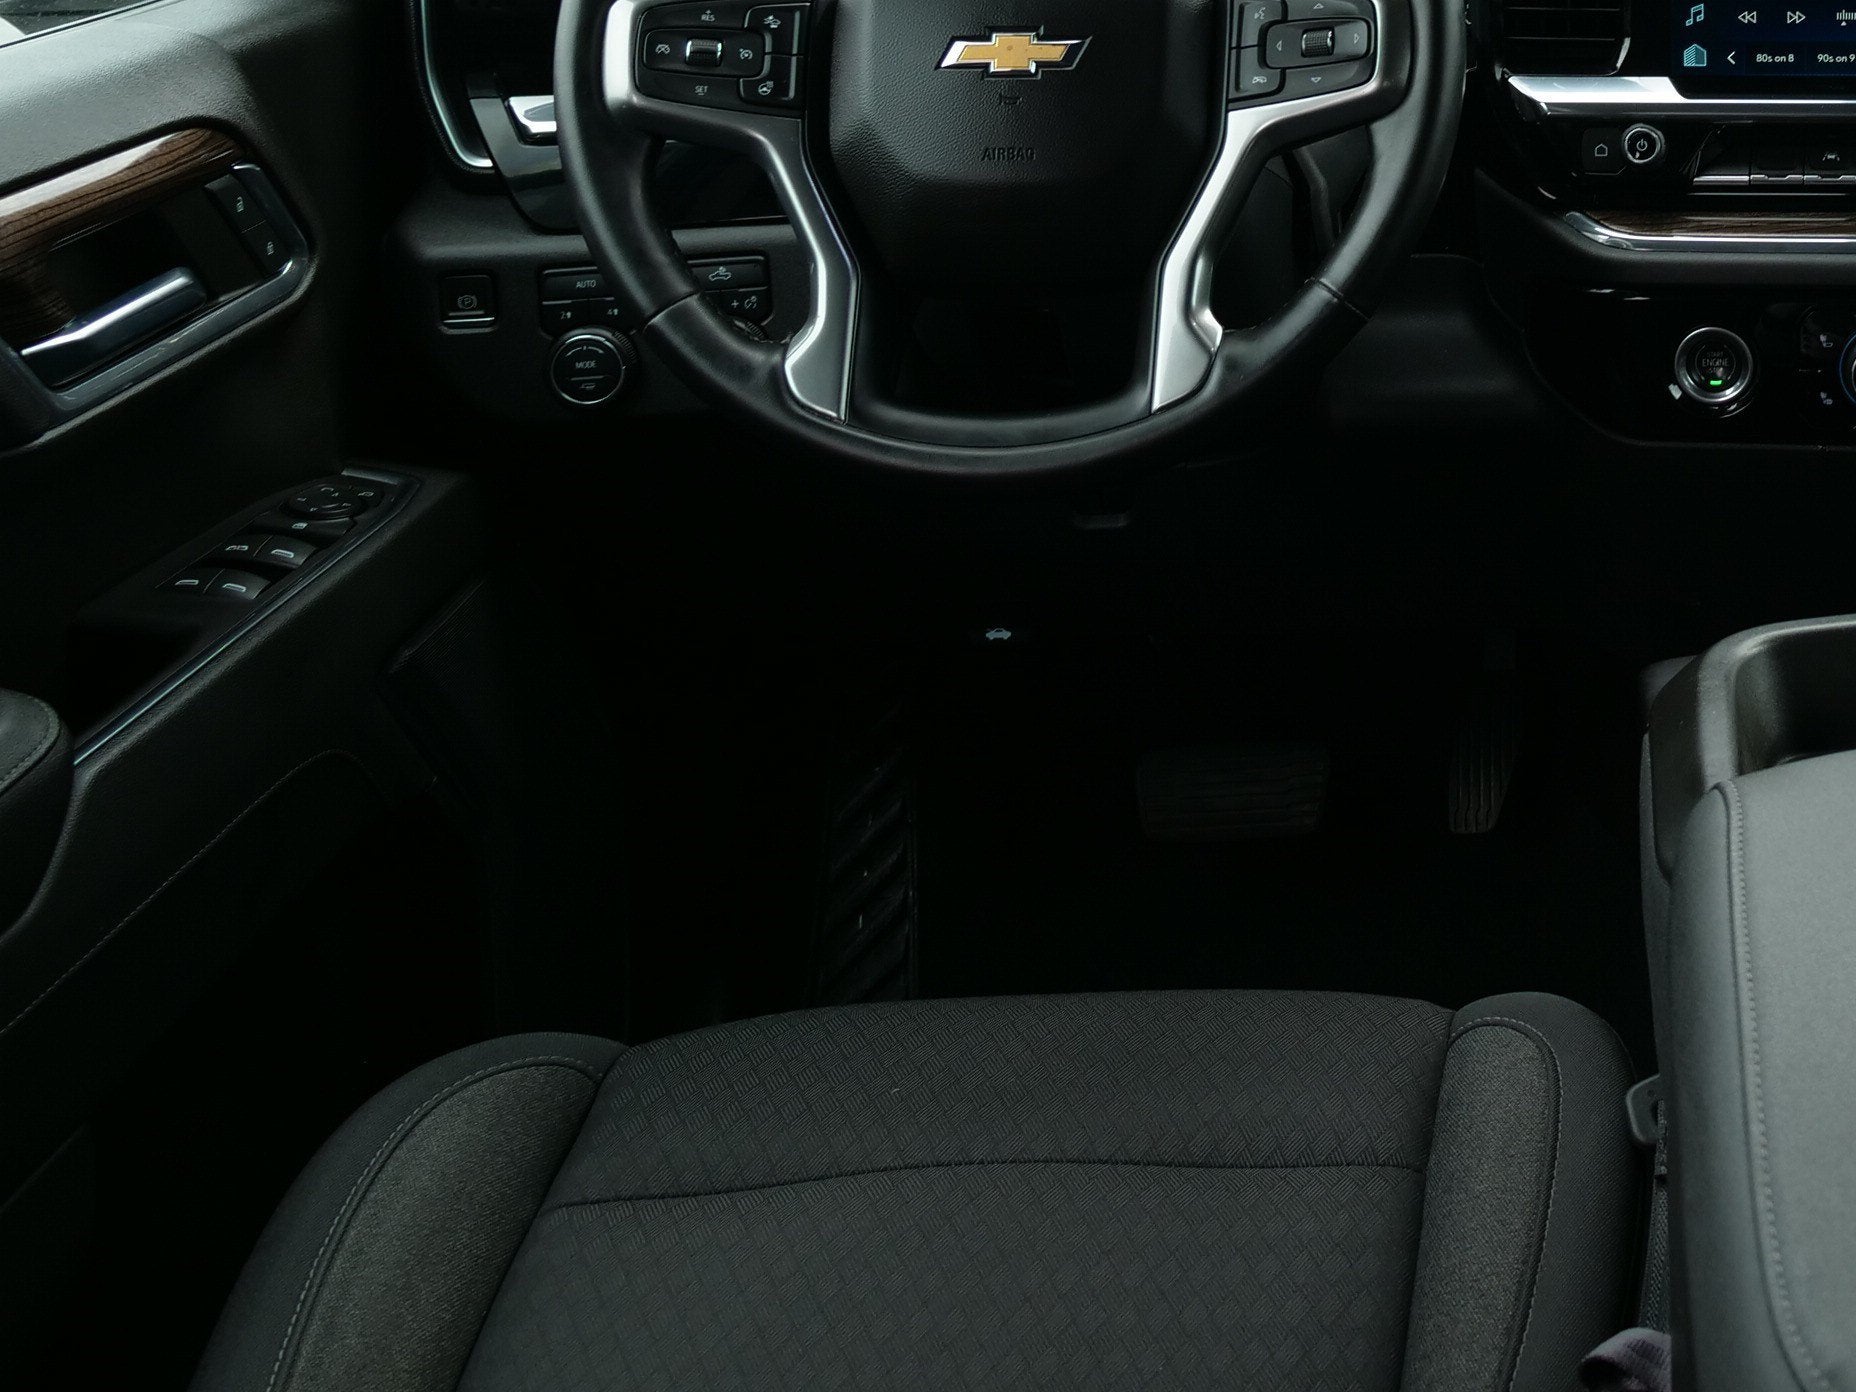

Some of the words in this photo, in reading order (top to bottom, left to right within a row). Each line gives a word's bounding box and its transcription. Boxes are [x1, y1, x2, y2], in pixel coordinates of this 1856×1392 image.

[701, 14, 716, 22] RES
[1756, 54, 1774, 62] 80s
[1790, 54, 1795, 62] 8
[1817, 54, 1834, 62] 90s
[1850, 54, 1856, 62] 9
[696, 86, 709, 94] SET
[576, 279, 598, 289] AUTO
[576, 360, 598, 370] MODE
[1702, 358, 1729, 366] ENGINE
